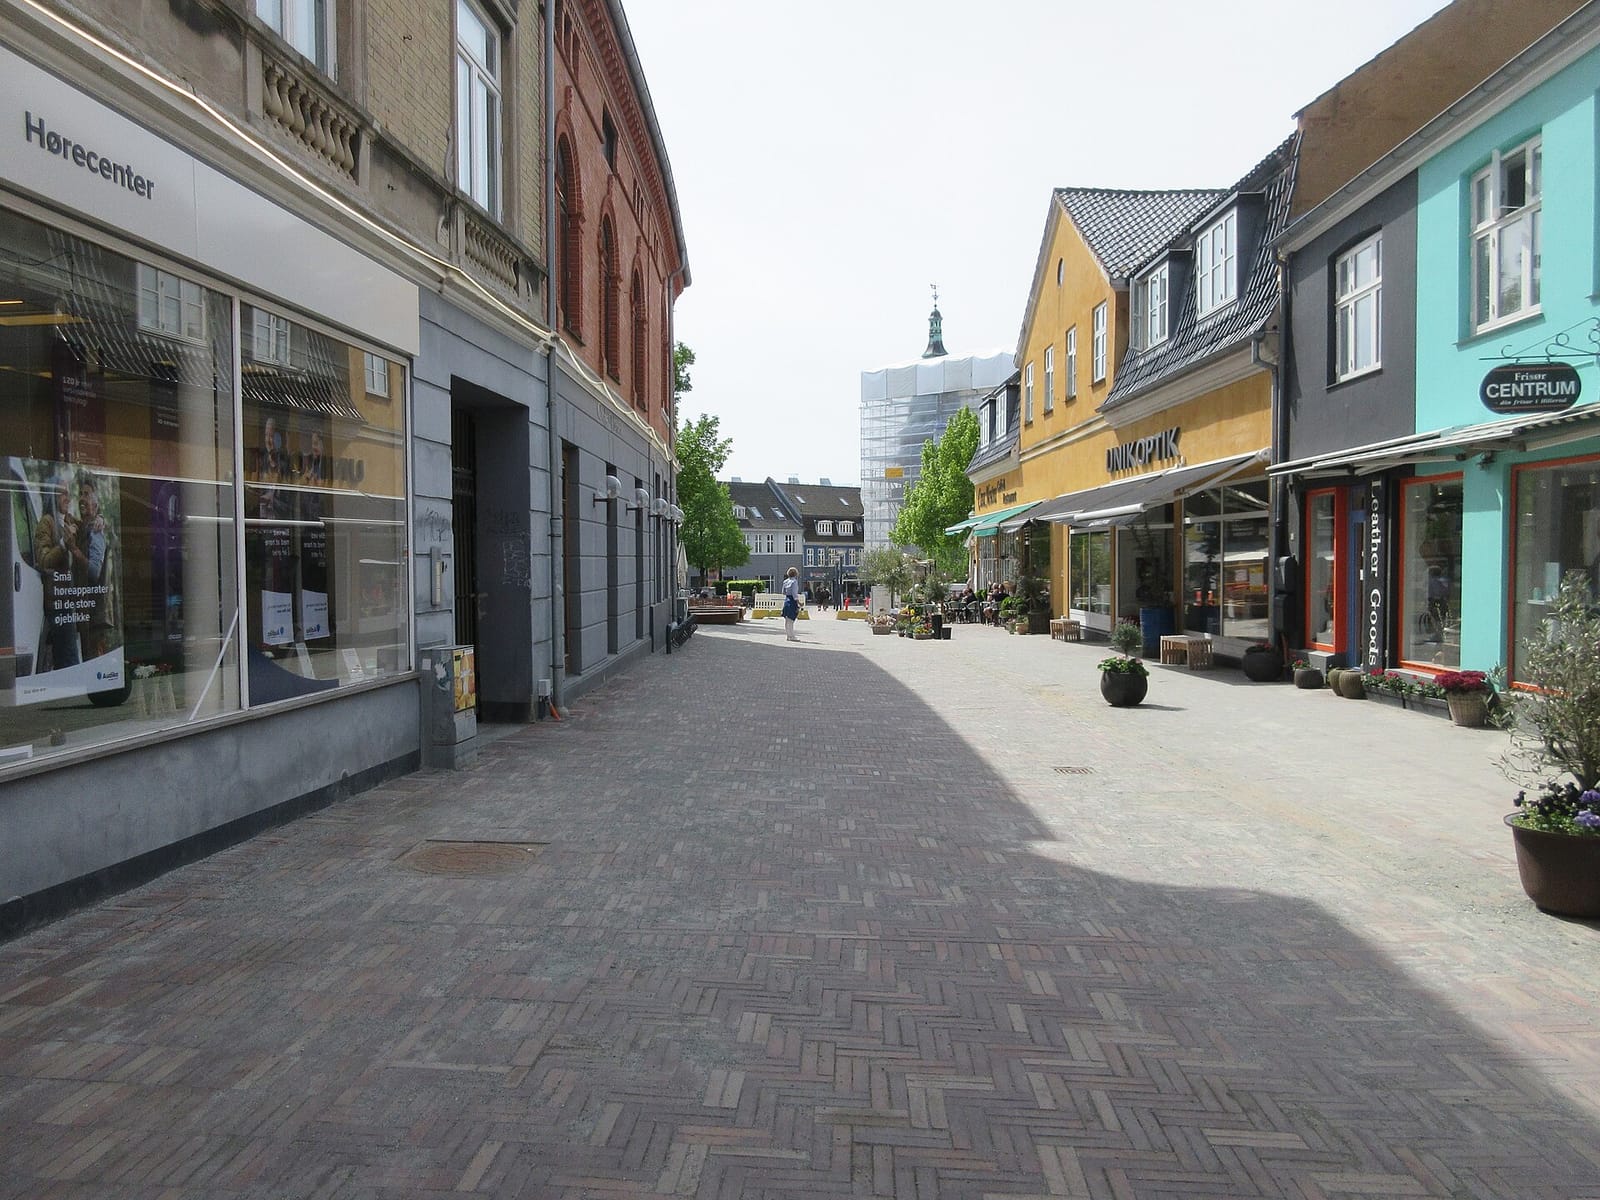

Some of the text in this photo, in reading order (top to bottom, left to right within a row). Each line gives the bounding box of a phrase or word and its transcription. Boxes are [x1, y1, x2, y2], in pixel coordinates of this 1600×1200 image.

[25, 111, 155, 200] Hørecenter
[1515, 372, 1547, 381] Frisør
[1486, 381, 1576, 398] CENTRUM
[1371, 480, 1382, 577] Leather
[53, 571, 72, 582] Små
[54, 600, 97, 610] til de store
[1369, 588, 1382, 666] Goods
